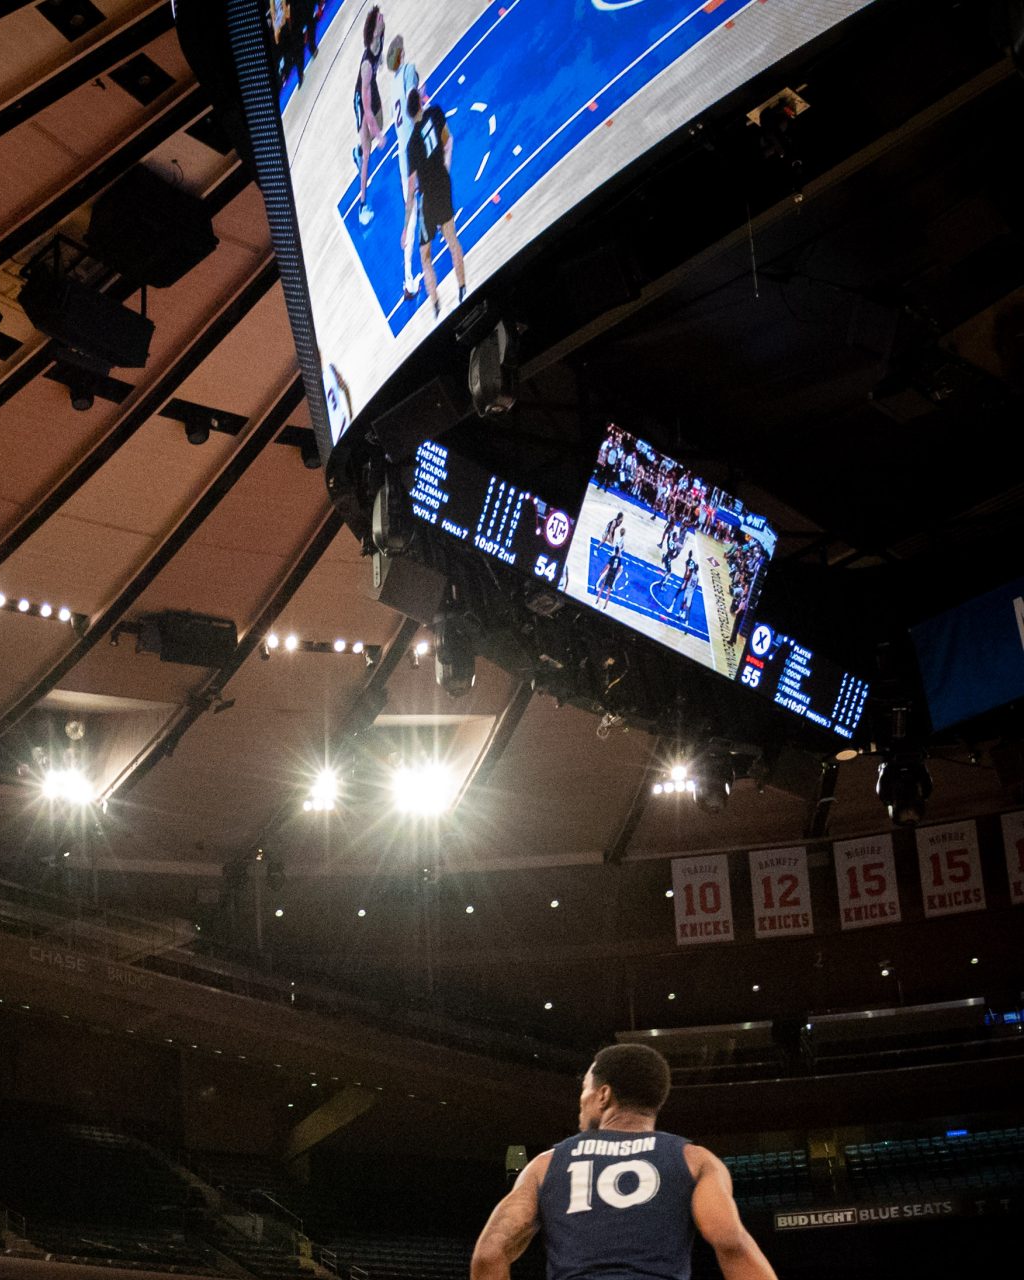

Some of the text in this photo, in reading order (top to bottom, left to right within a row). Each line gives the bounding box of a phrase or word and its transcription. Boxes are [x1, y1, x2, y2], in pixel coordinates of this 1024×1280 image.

[420, 459, 447, 480] ACKSON
[421, 449, 446, 468] HEFNER
[474, 535, 499, 557] 10:07
[498, 547, 516, 565] 2nd
[534, 555, 557, 582] 54
[741, 665, 761, 688] 55
[846, 862, 887, 899] 15
[929, 849, 972, 887] 15
[683, 881, 721, 917] 10
[761, 874, 801, 910] 12
[927, 888, 982, 911] KNICKS
[758, 912, 809, 932] KNICKS
[843, 903, 897, 923] KNICKS
[679, 919, 731, 938] KNICKS
[571, 1136, 657, 1157] JOHNSON
[565, 1158, 661, 1215] 10
[777, 1201, 953, 1228] BUD LIGHT BLUE SEATS
